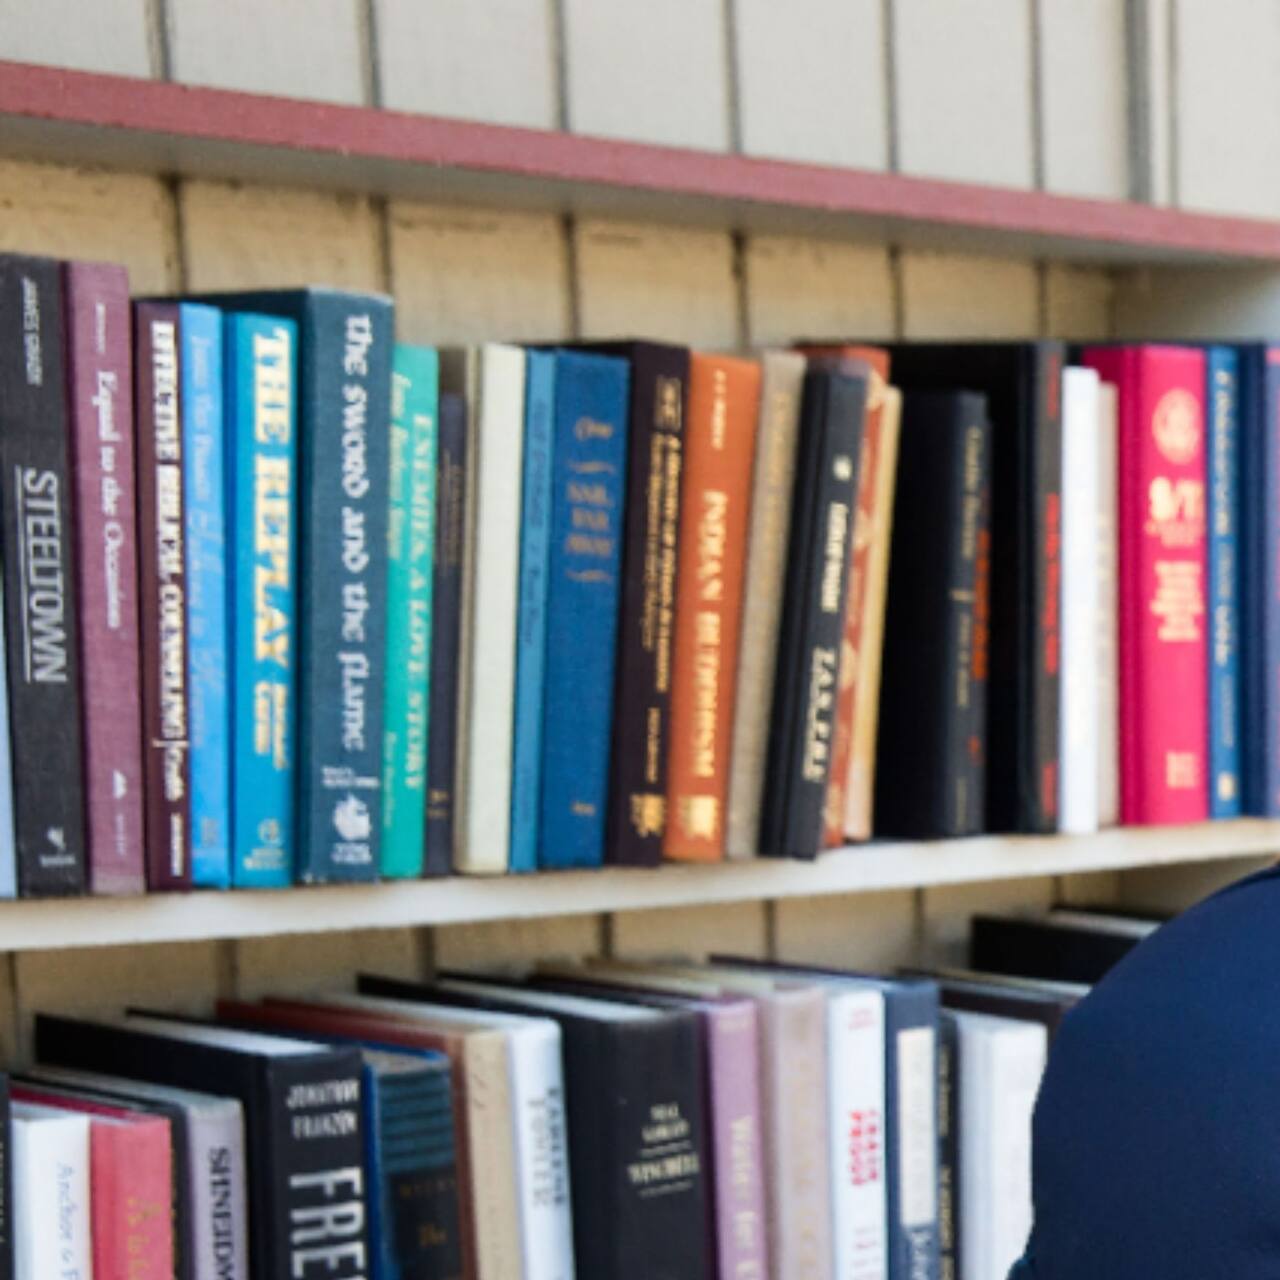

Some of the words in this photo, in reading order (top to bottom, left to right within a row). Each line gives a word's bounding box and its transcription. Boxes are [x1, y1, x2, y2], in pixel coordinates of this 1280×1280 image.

[92, 370, 122, 443] Equal
[152, 320, 181, 460] EFFECTIVE
[254, 327, 292, 443] THE
[100, 446, 117, 472] to
[101, 475, 123, 516] the
[23, 466, 67, 683] STEELTOWN
[103, 521, 126, 628] Occasion
[157, 463, 184, 581] BIBLICAL
[254, 453, 292, 668] REPLAY
[697, 490, 729, 601] INDIAN
[160, 583, 185, 738] COUNSELING
[694, 610, 722, 777] BUDDHISM
[404, 691, 426, 788] STORY
